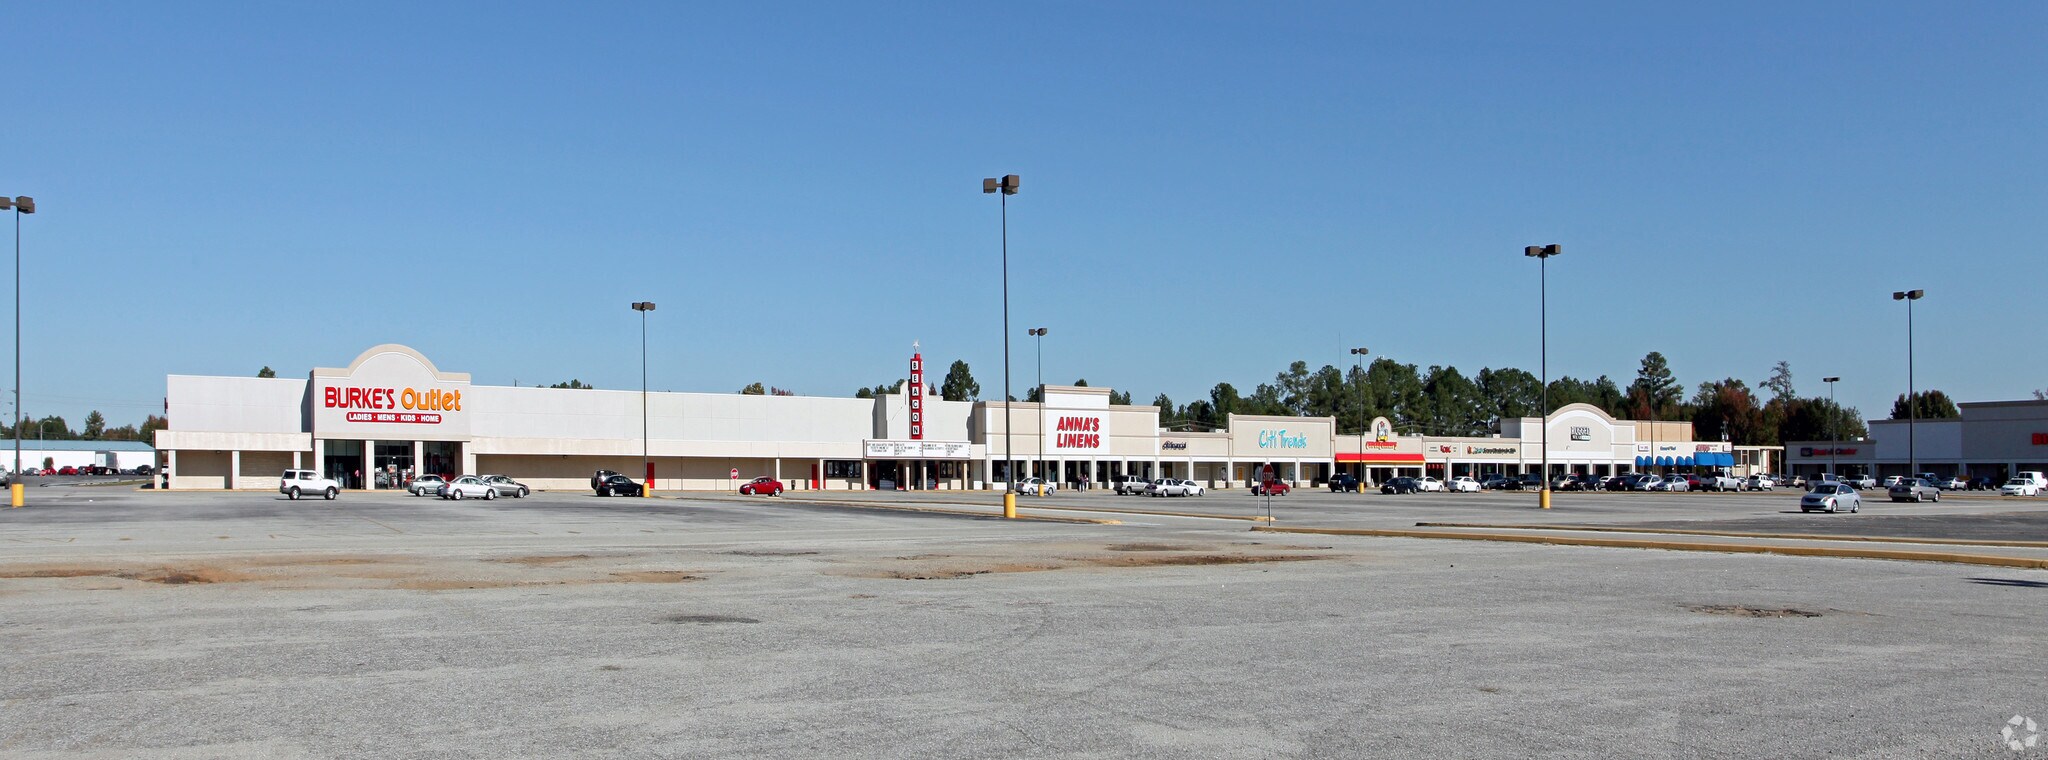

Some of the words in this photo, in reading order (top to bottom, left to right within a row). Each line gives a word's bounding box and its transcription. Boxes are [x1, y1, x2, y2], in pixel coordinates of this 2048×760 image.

[325, 386, 395, 409] BURKE'S
[401, 387, 461, 411] Outlet
[911, 361, 919, 435] BEACON
[348, 413, 372, 421] LADIES
[1056, 417, 1100, 432] ANNA'S
[1056, 433, 1100, 448] LINENS
[1278, 429, 1307, 448] Trends
[1263, 472, 1274, 481] STOP
